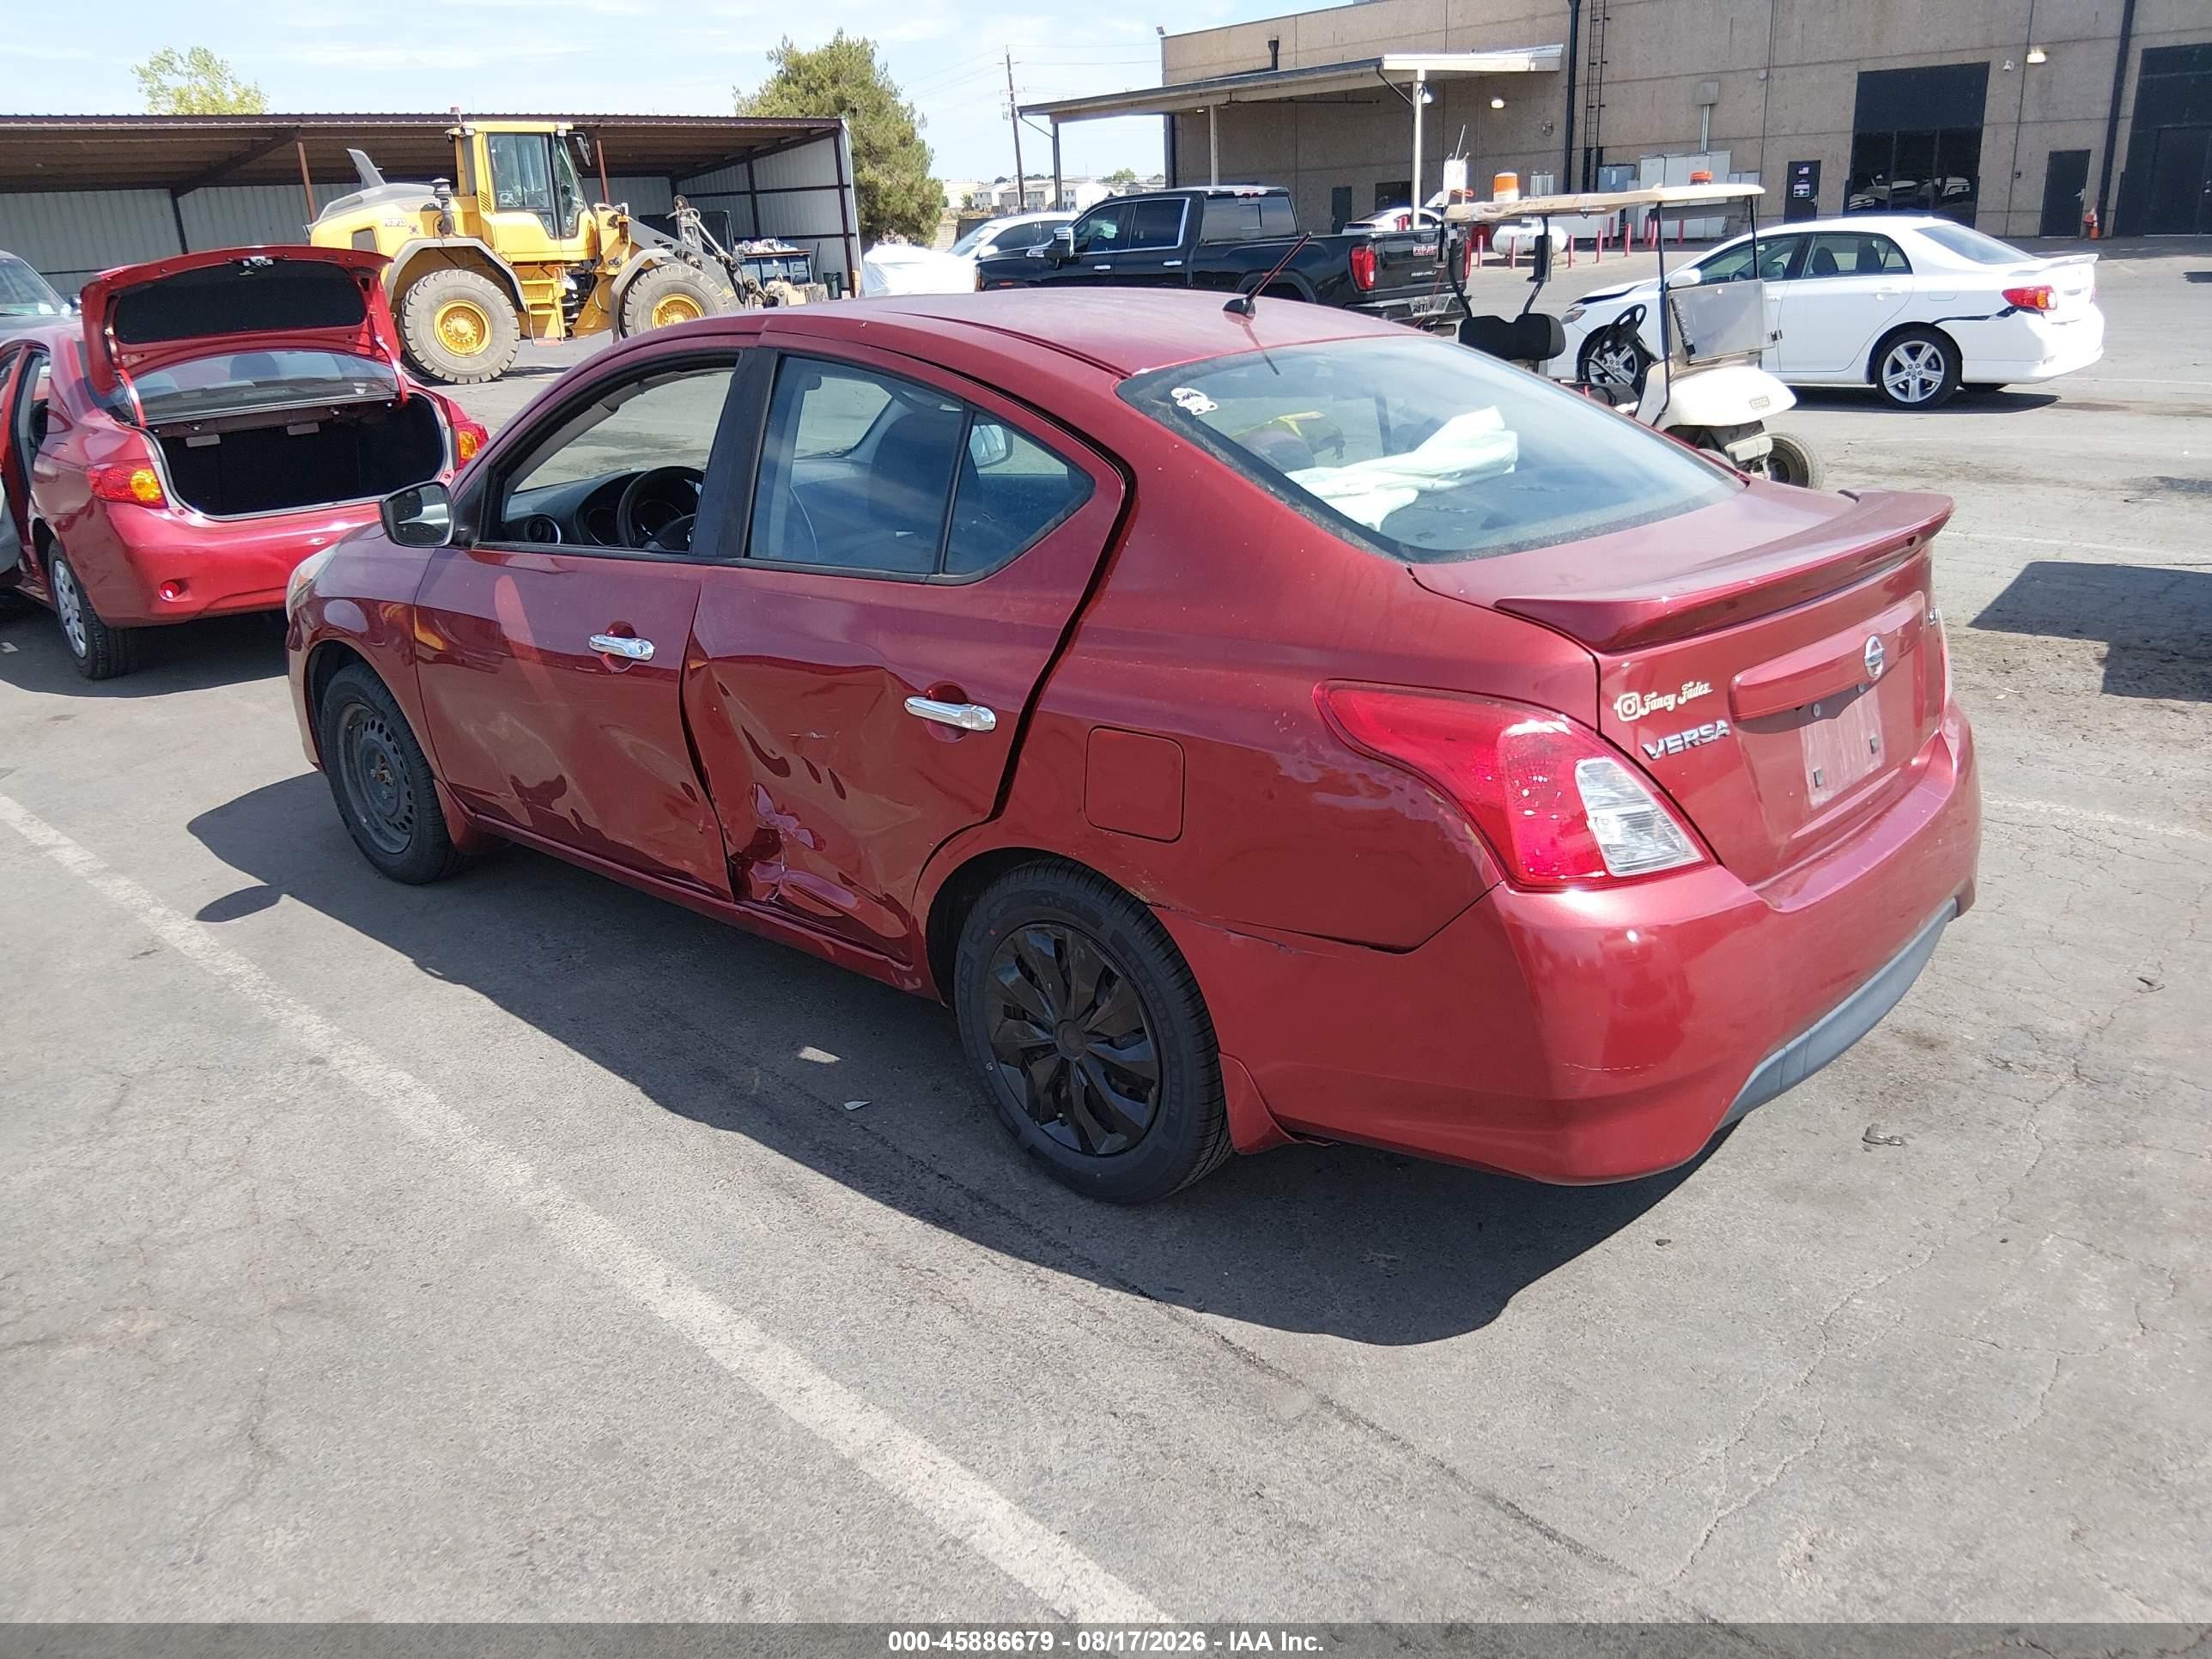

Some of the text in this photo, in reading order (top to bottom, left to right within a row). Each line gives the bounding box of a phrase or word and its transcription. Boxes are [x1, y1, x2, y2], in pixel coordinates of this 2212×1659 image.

[1639, 681, 1714, 716] Fancy Fades
[1641, 720, 1731, 759] VERSA
